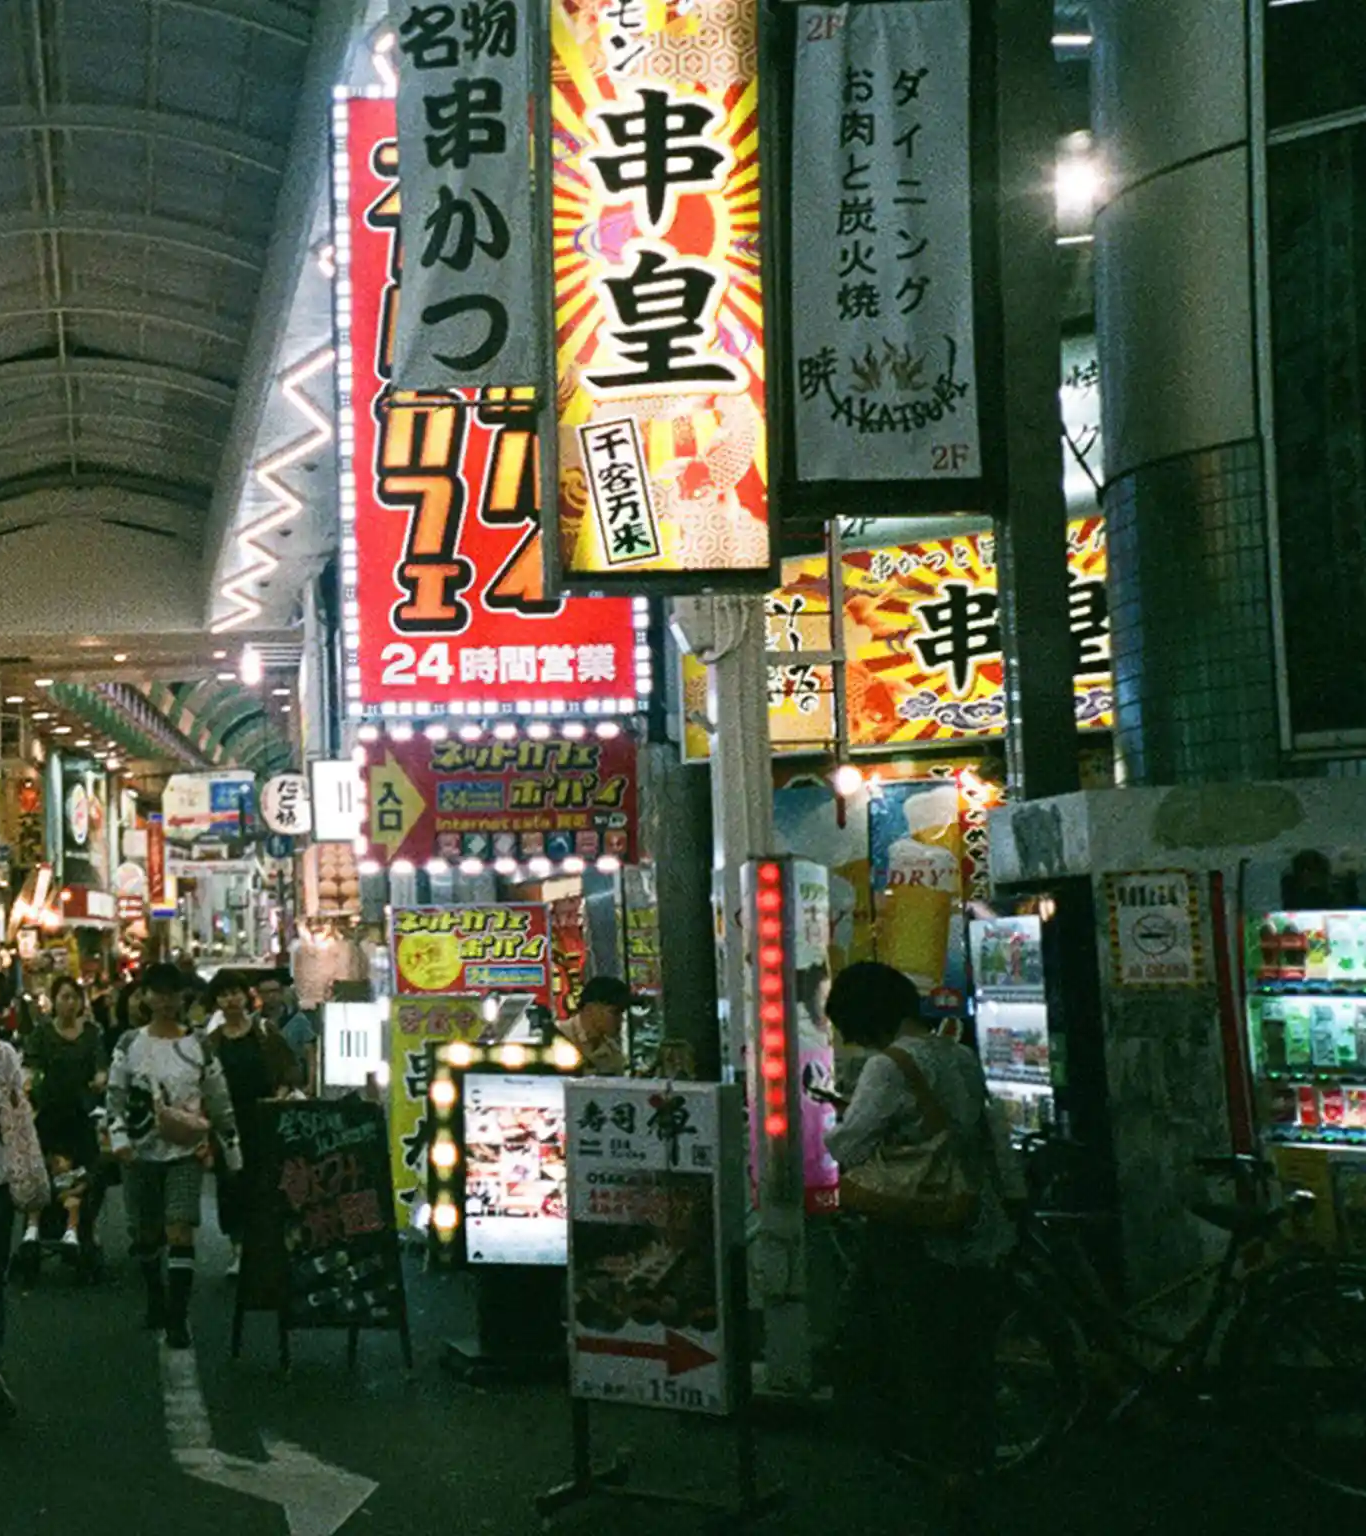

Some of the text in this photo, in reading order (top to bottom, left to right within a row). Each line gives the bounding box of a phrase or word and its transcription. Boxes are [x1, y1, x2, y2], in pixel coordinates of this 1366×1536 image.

[805, 17, 843, 42] 2F
[837, 69, 880, 321] お肉と炭火焼
[891, 67, 933, 315] ダイニング
[420, 78, 511, 373] 串かつ
[588, 88, 738, 388] 串皇
[931, 445, 970, 471] 2F
[592, 430, 650, 554] 千客万来
[381, 643, 617, 686] 24時間営業
[431, 738, 601, 772] ネットカフェ
[378, 782, 403, 832] 入口
[507, 776, 629, 811] ポパイ
[394, 909, 530, 933] ネットカフェ
[459, 936, 548, 961] ポパイ
[575, 1099, 637, 1134] 寿司
